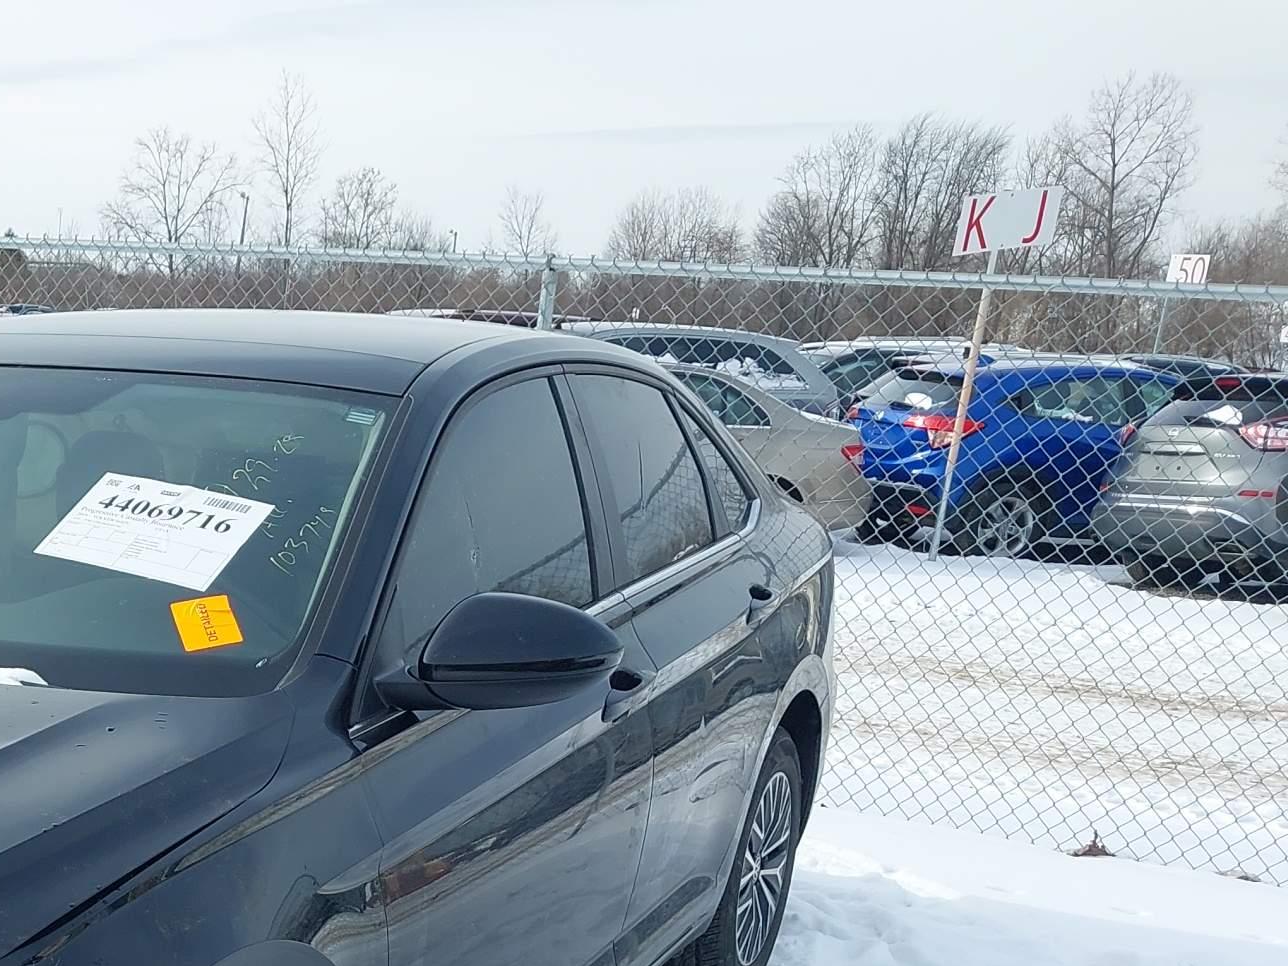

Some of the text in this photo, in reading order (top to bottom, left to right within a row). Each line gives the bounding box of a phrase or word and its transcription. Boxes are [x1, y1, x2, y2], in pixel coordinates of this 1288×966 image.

[962, 189, 1049, 252] K J
[1179, 256, 1206, 284] 50
[98, 494, 239, 533] 44069716
